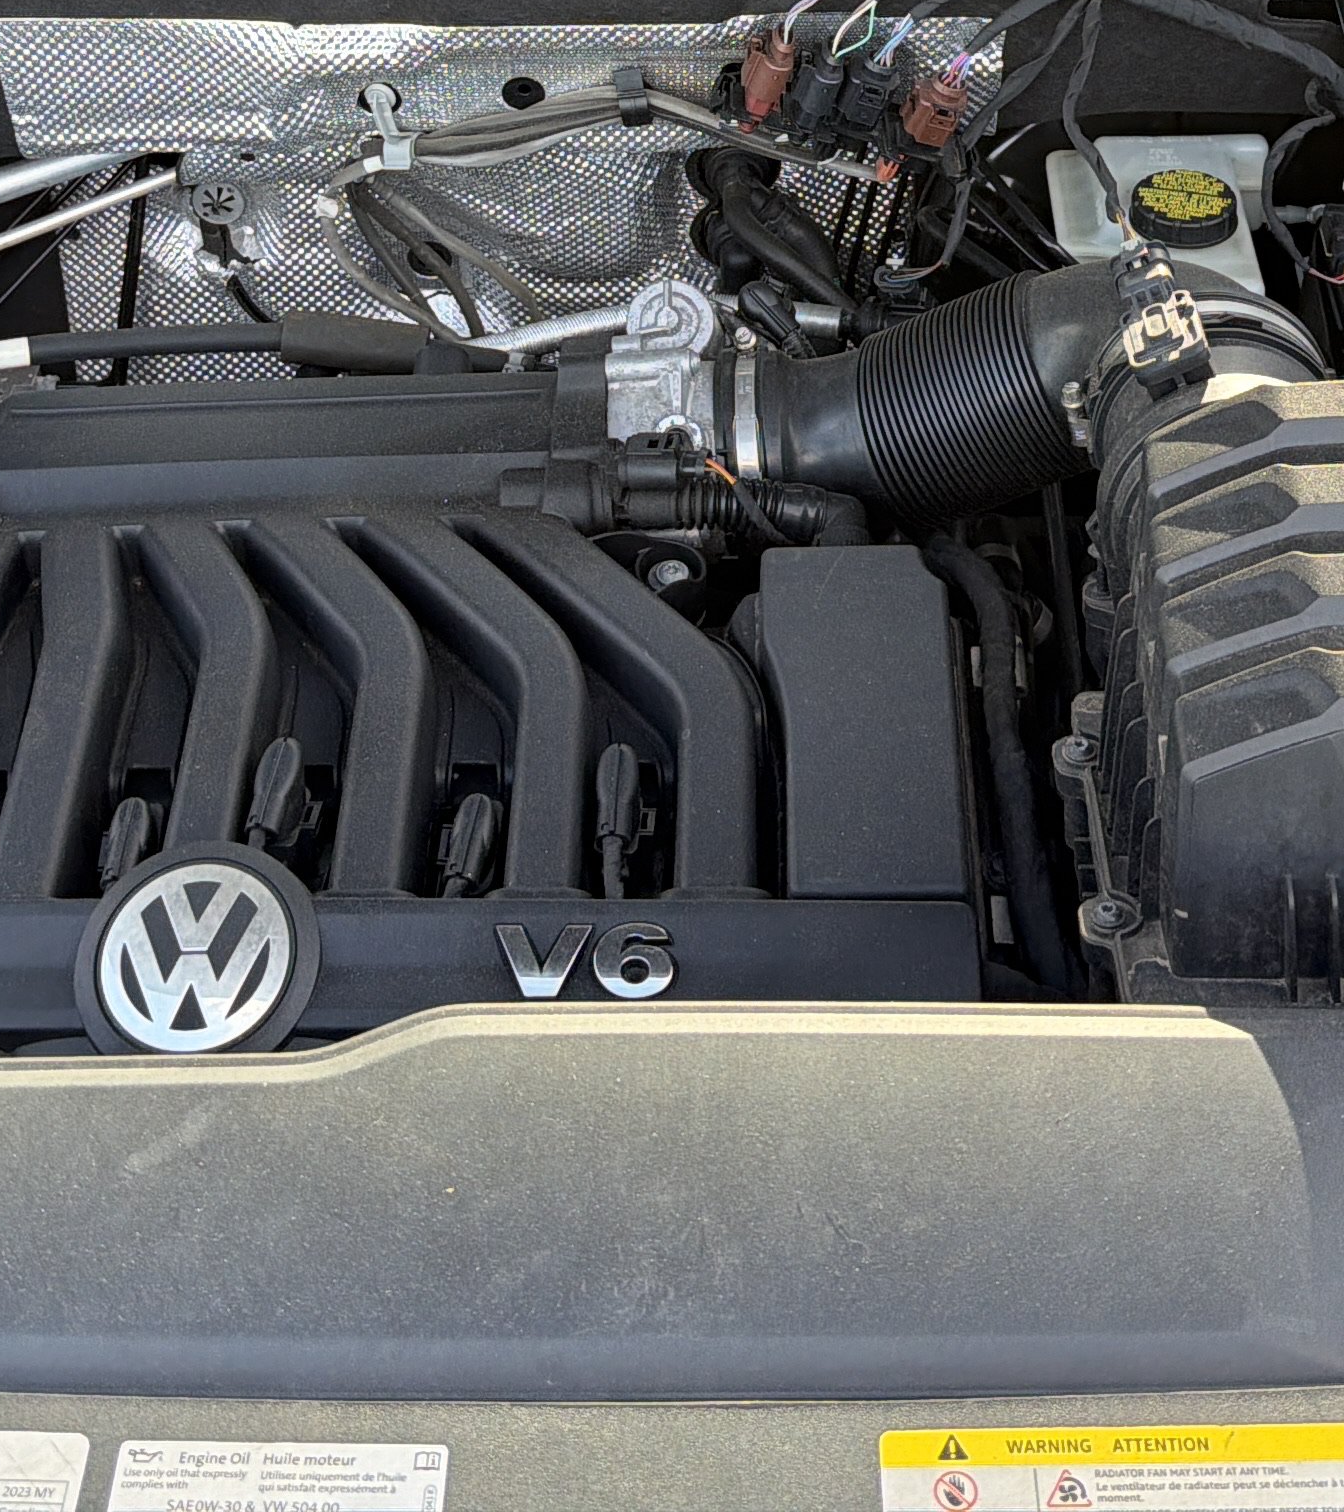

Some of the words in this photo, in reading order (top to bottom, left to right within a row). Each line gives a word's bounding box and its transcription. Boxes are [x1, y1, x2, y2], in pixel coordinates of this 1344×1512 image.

[495, 922, 676, 999] V6
[1006, 1438, 1092, 1454] WARNING
[1113, 1437, 1209, 1453] ATTENTION
[179, 1452, 227, 1467] Engine
[230, 1452, 250, 1465] Oil
[263, 1453, 300, 1465] Huile
[303, 1454, 356, 1466] moteur
[123, 1468, 142, 1478] Use
[143, 1469, 164, 1480] only
[166, 1468, 178, 1478] oil
[180, 1468, 200, 1478] that
[202, 1470, 248, 1481] expressly
[299, 1471, 360, 1483] uniquement
[362, 1472, 375, 1482] de
[1094, 1468, 1145, 1478] RADIATOR
[1147, 1468, 1167, 1477] FAN
[1169, 1468, 1191, 1477] MAY
[1193, 1467, 1223, 1476] START
[1225, 1467, 1237, 1476] AT
[1239, 1467, 1259, 1476] ANY
[1262, 1466, 1289, 1475] TIME.
[120, 1480, 164, 1490] complies
[166, 1481, 189, 1489] with
[258, 1484, 275, 1494] qui
[1096, 1482, 1109, 1491] Le
[1110, 1481, 1166, 1490] ventilateur
[1168, 1481, 1182, 1490] de
[1184, 1480, 1230, 1490] radiateur
[1233, 1480, 1257, 1491] peut
[1259, 1481, 1271, 1489] se
[2, 1486, 31, 1498] 2023
[34, 1487, 56, 1498] MY
[1097, 1494, 1145, 1503] moment.
[263, 1501, 290, 1512] VW
[292, 1502, 319, 1512] 504
[321, 1502, 340, 1512] 00
